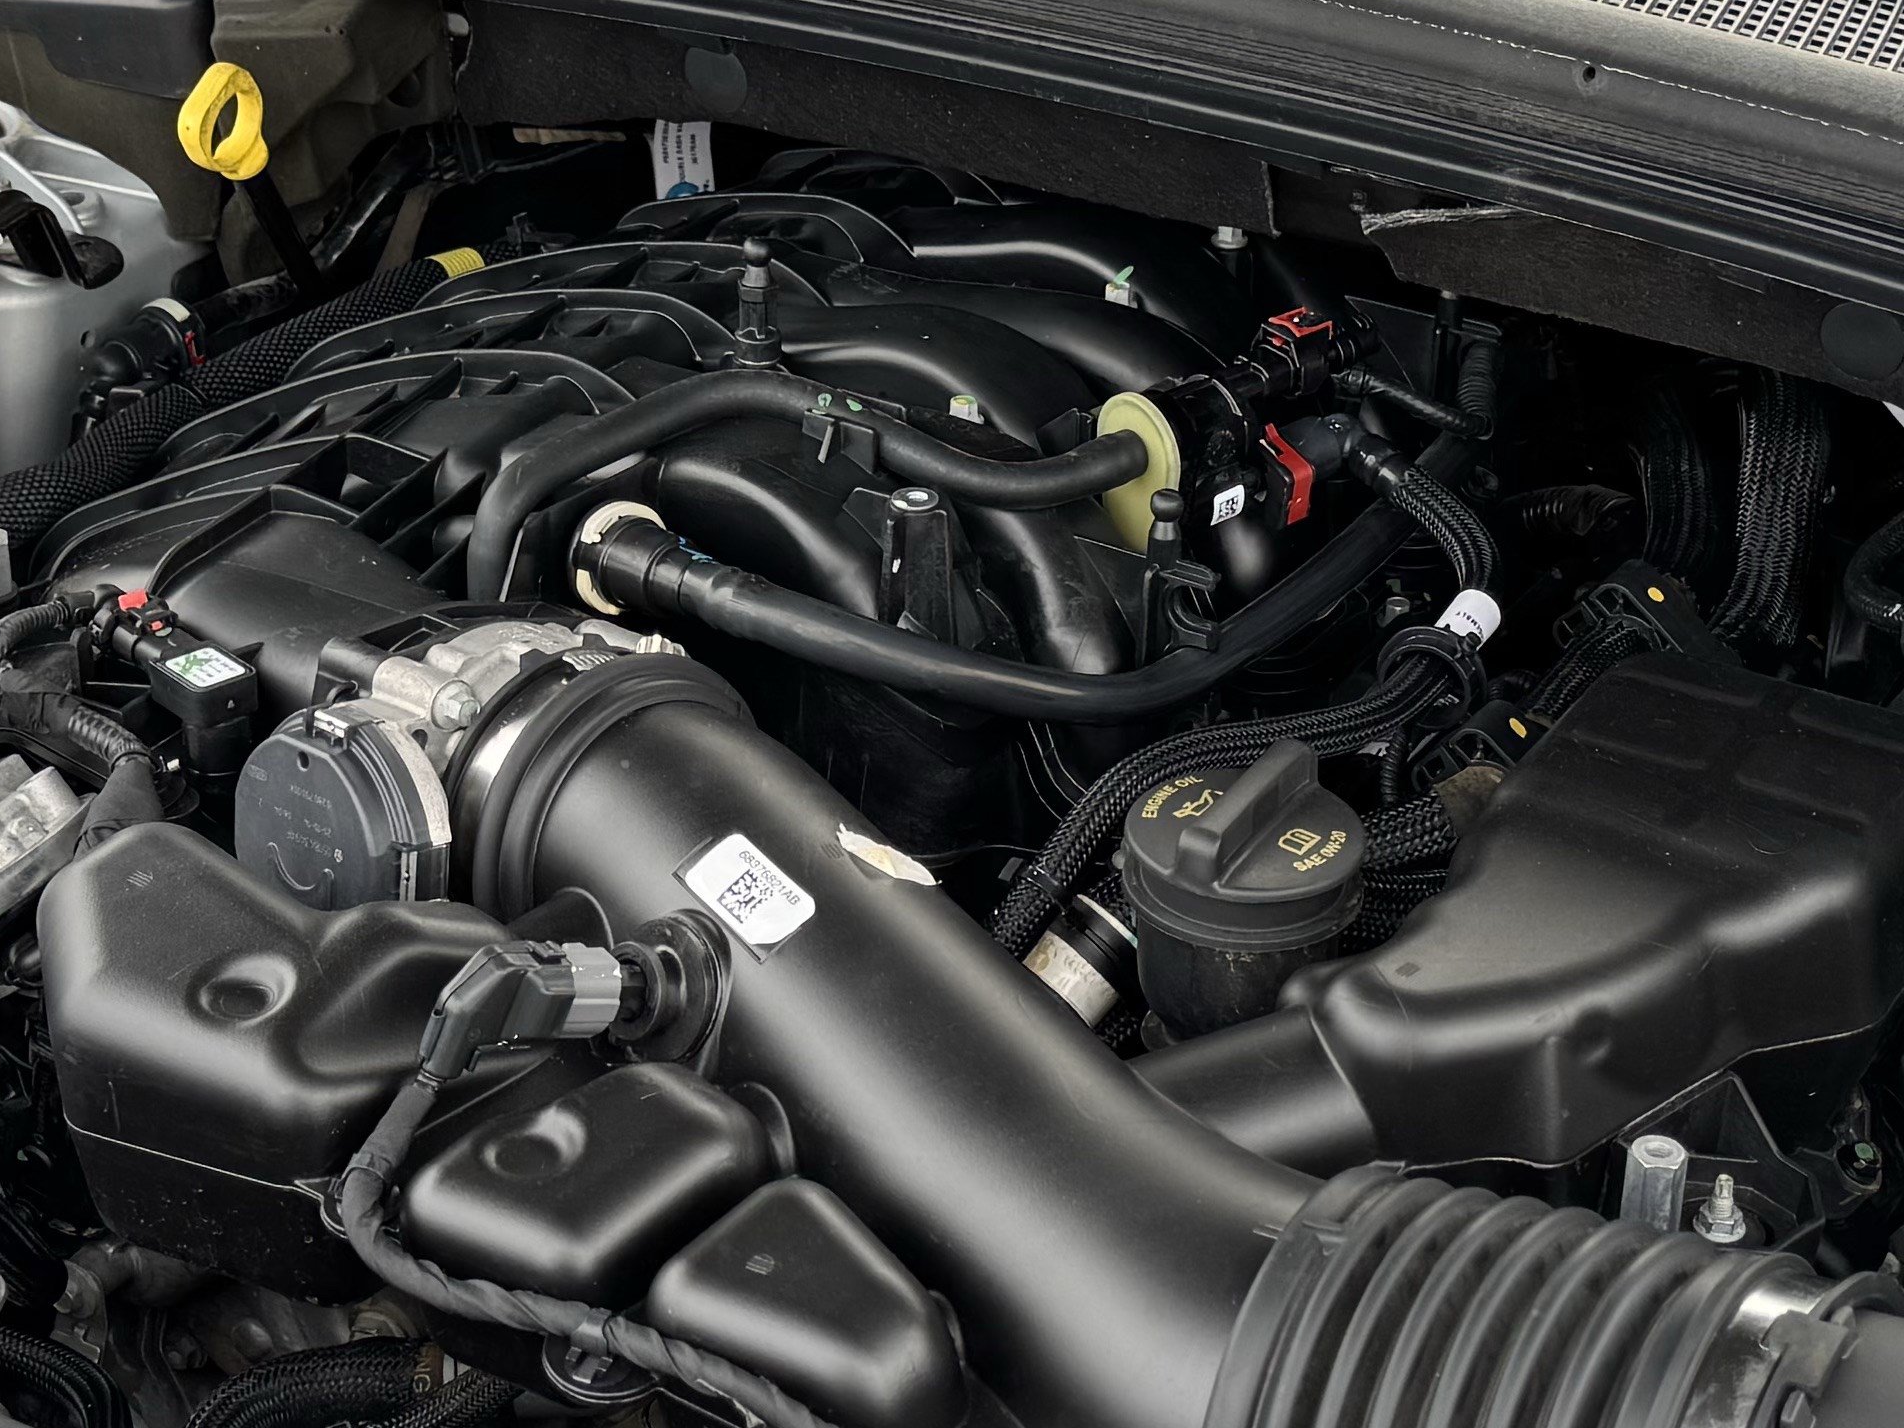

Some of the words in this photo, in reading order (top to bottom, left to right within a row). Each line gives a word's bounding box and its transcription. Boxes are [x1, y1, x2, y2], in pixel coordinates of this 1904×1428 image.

[1141, 783, 1178, 820] ENGINE
[1174, 775, 1204, 789] OIL
[1292, 853, 1328, 873] SAE
